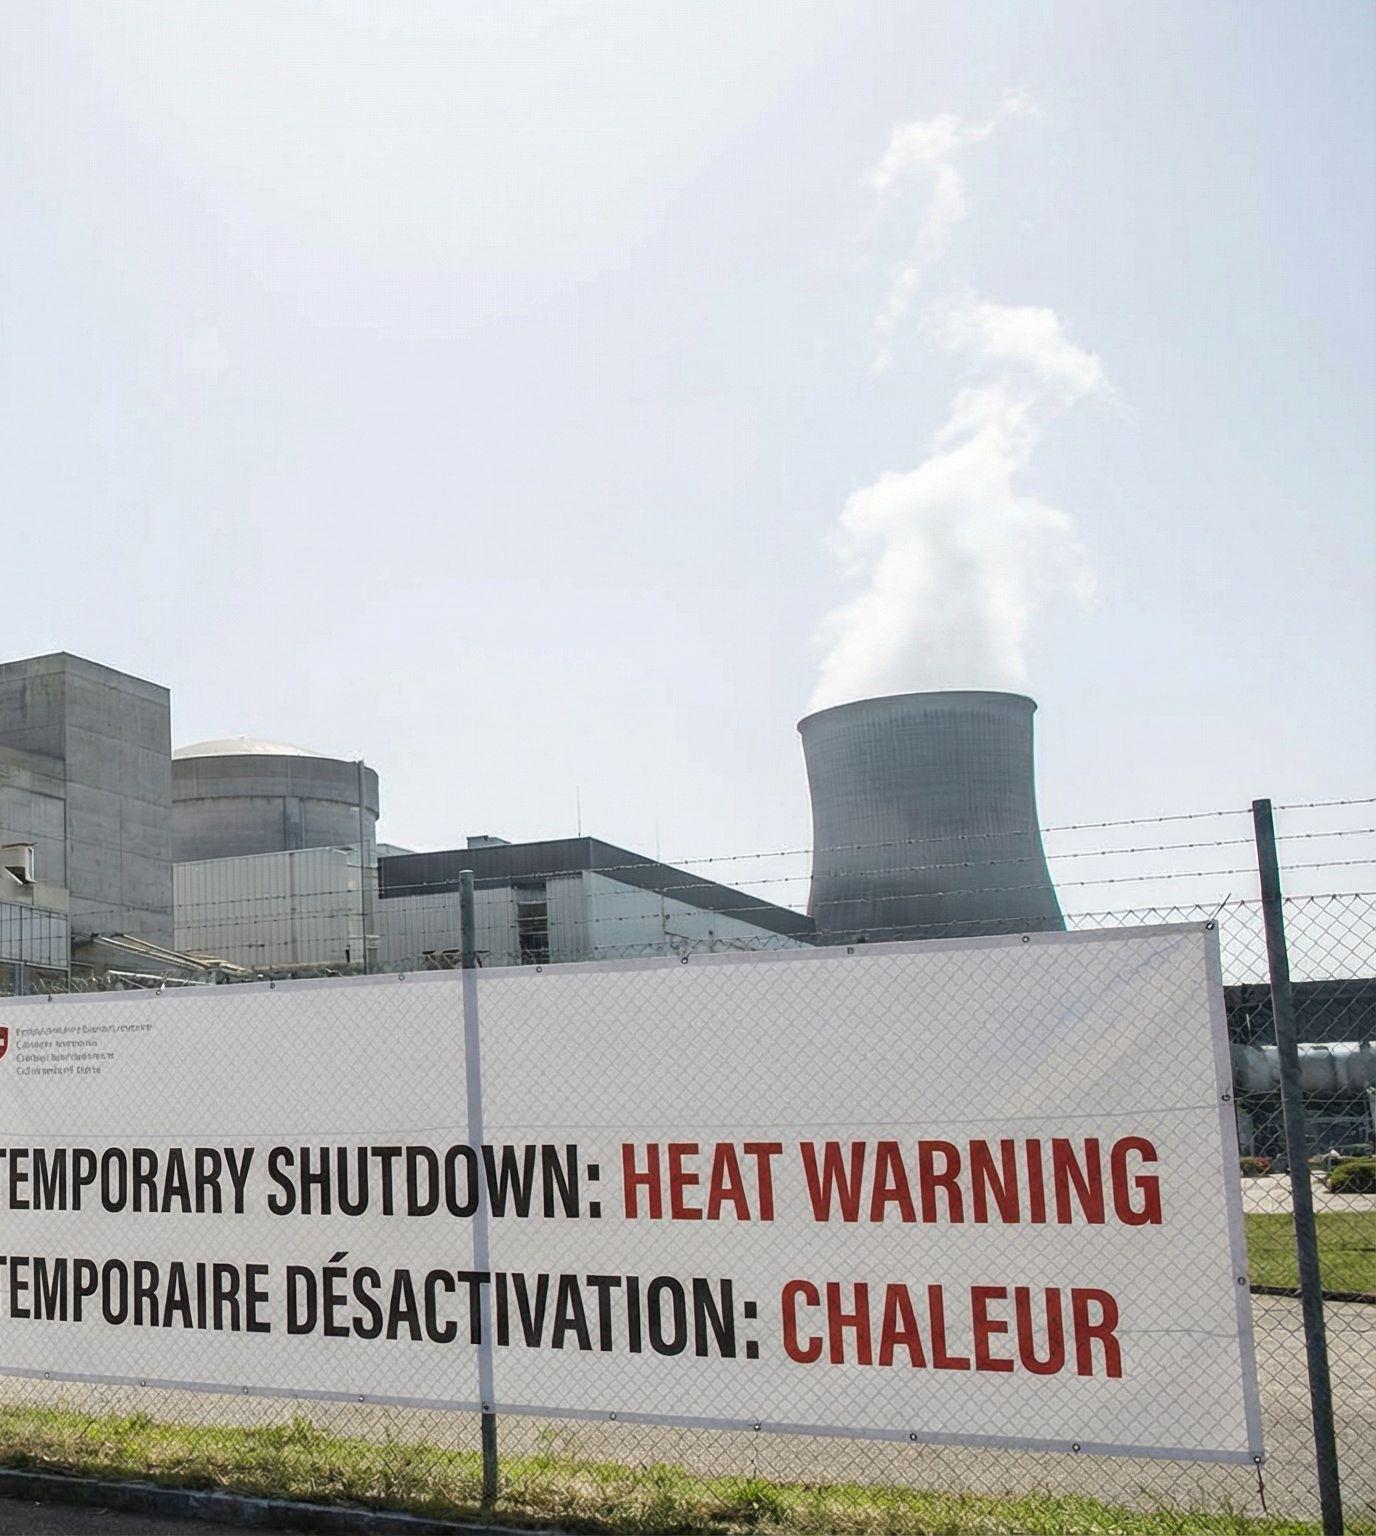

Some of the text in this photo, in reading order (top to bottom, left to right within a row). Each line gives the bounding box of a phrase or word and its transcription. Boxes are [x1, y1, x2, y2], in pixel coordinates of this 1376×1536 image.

[266, 1143, 602, 1219] SHUTDOWN:
[621, 1141, 784, 1223] HEAT
[799, 1136, 1164, 1226] WARNING
[286, 1251, 760, 1360] DÉSACTIVATION:
[780, 1279, 1124, 1379] CHALEUR
